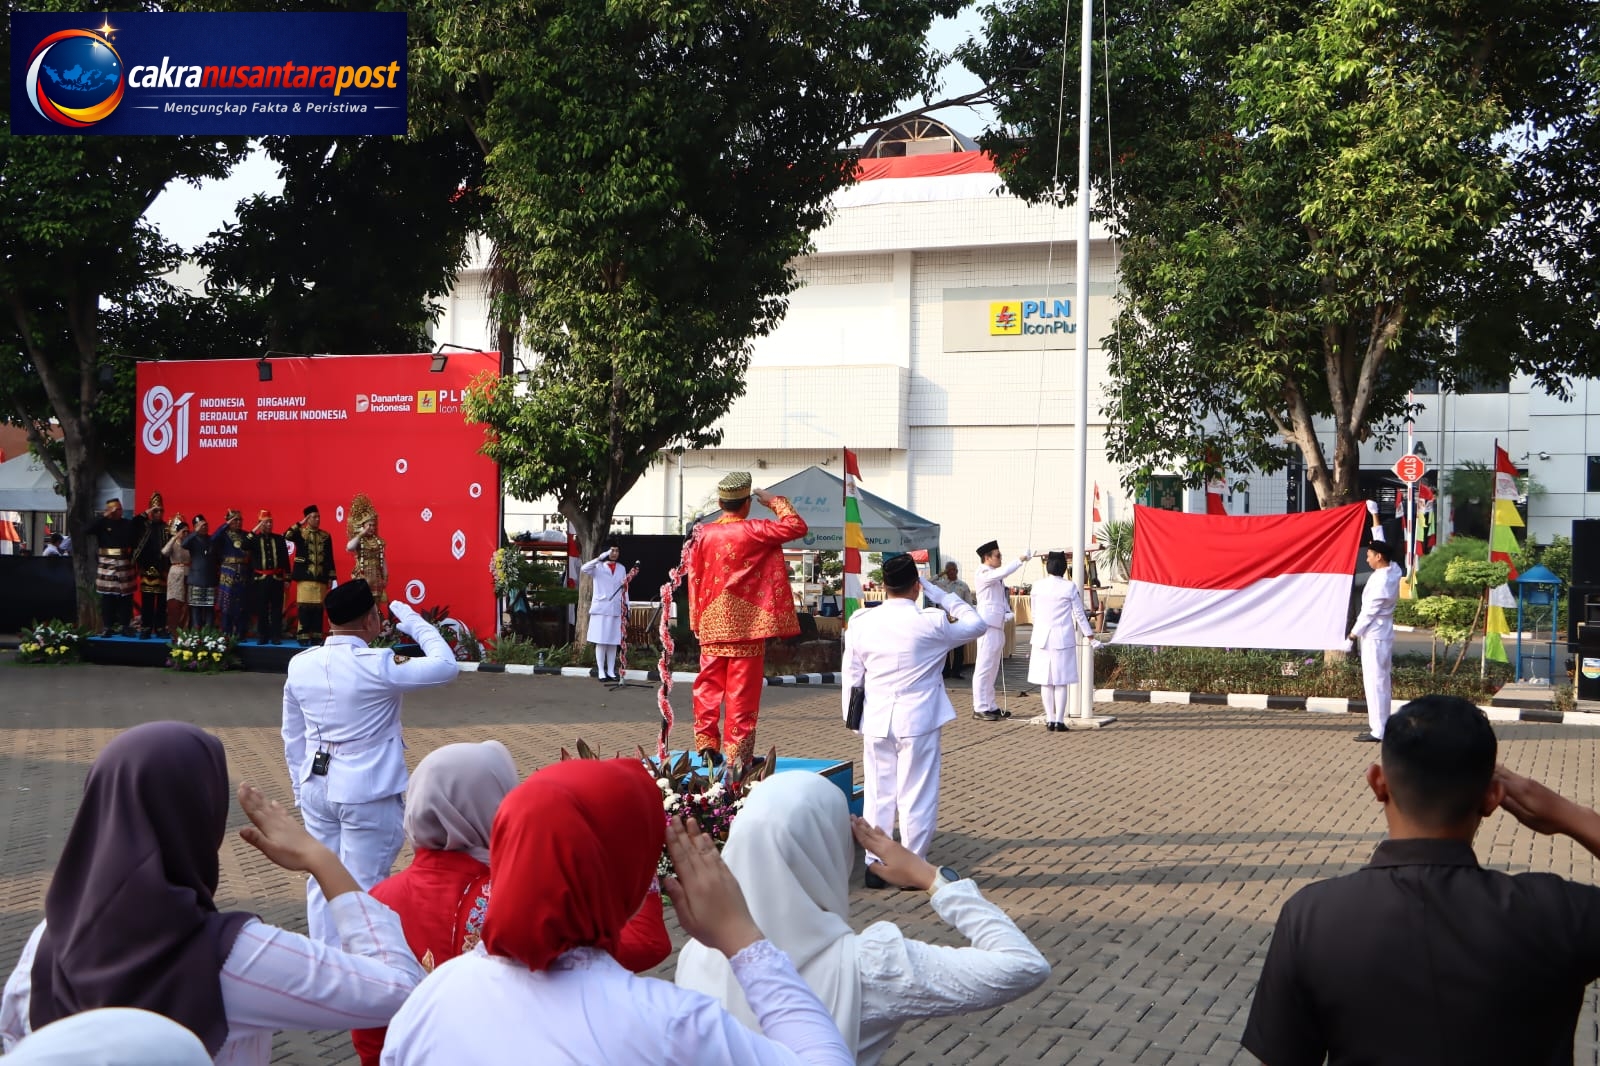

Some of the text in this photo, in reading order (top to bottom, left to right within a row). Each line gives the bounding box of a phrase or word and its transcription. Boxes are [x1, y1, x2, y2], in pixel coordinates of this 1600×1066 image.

[1023, 299, 1071, 319] PLN
[200, 398, 245, 408] INDONESIA
[257, 397, 306, 407] DIRGAHAYU
[370, 394, 413, 403] Danantara
[370, 403, 411, 412] Indonesia
[439, 404, 458, 413] Icon
[200, 411, 248, 421] BERDAULAT
[257, 410, 347, 421] REPUBLIK INDONESIA
[142, 385, 195, 463] 81
[199, 425, 238, 435] ADIL DAN
[199, 438, 238, 448] MAKMUR
[1404, 457, 1417, 480] STOP
[792, 496, 827, 505] PLN
